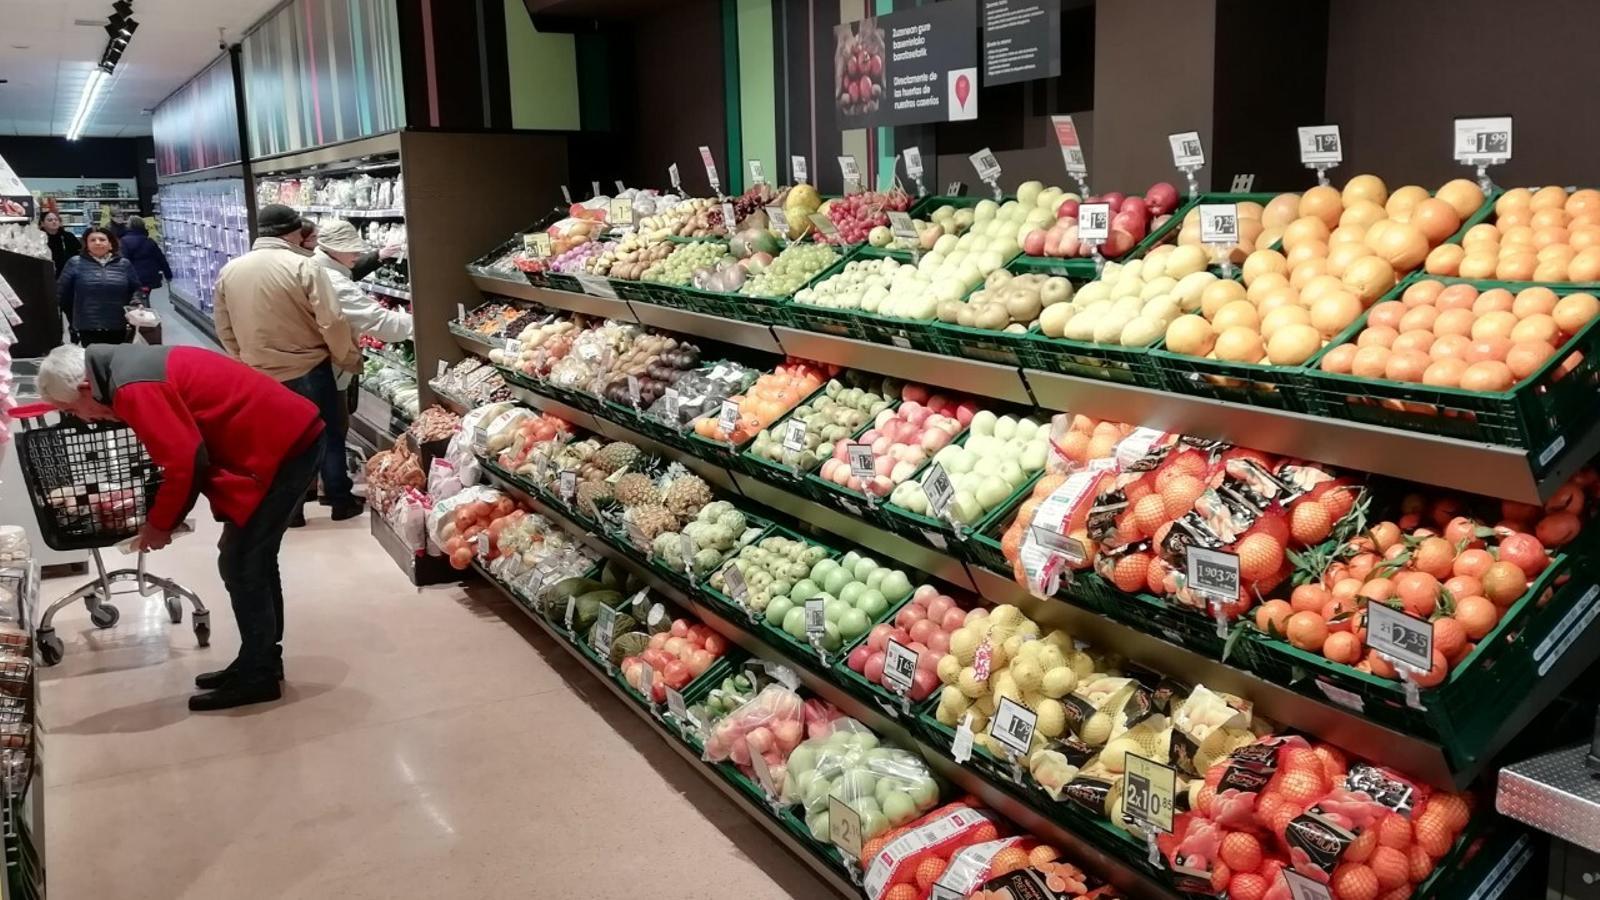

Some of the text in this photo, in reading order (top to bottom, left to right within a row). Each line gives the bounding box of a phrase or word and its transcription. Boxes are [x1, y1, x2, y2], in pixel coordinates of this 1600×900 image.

[929, 71, 938, 81] de
[894, 89, 902, 98] las
[922, 84, 931, 94] de
[1392, 626, 1427, 649] 2.35
